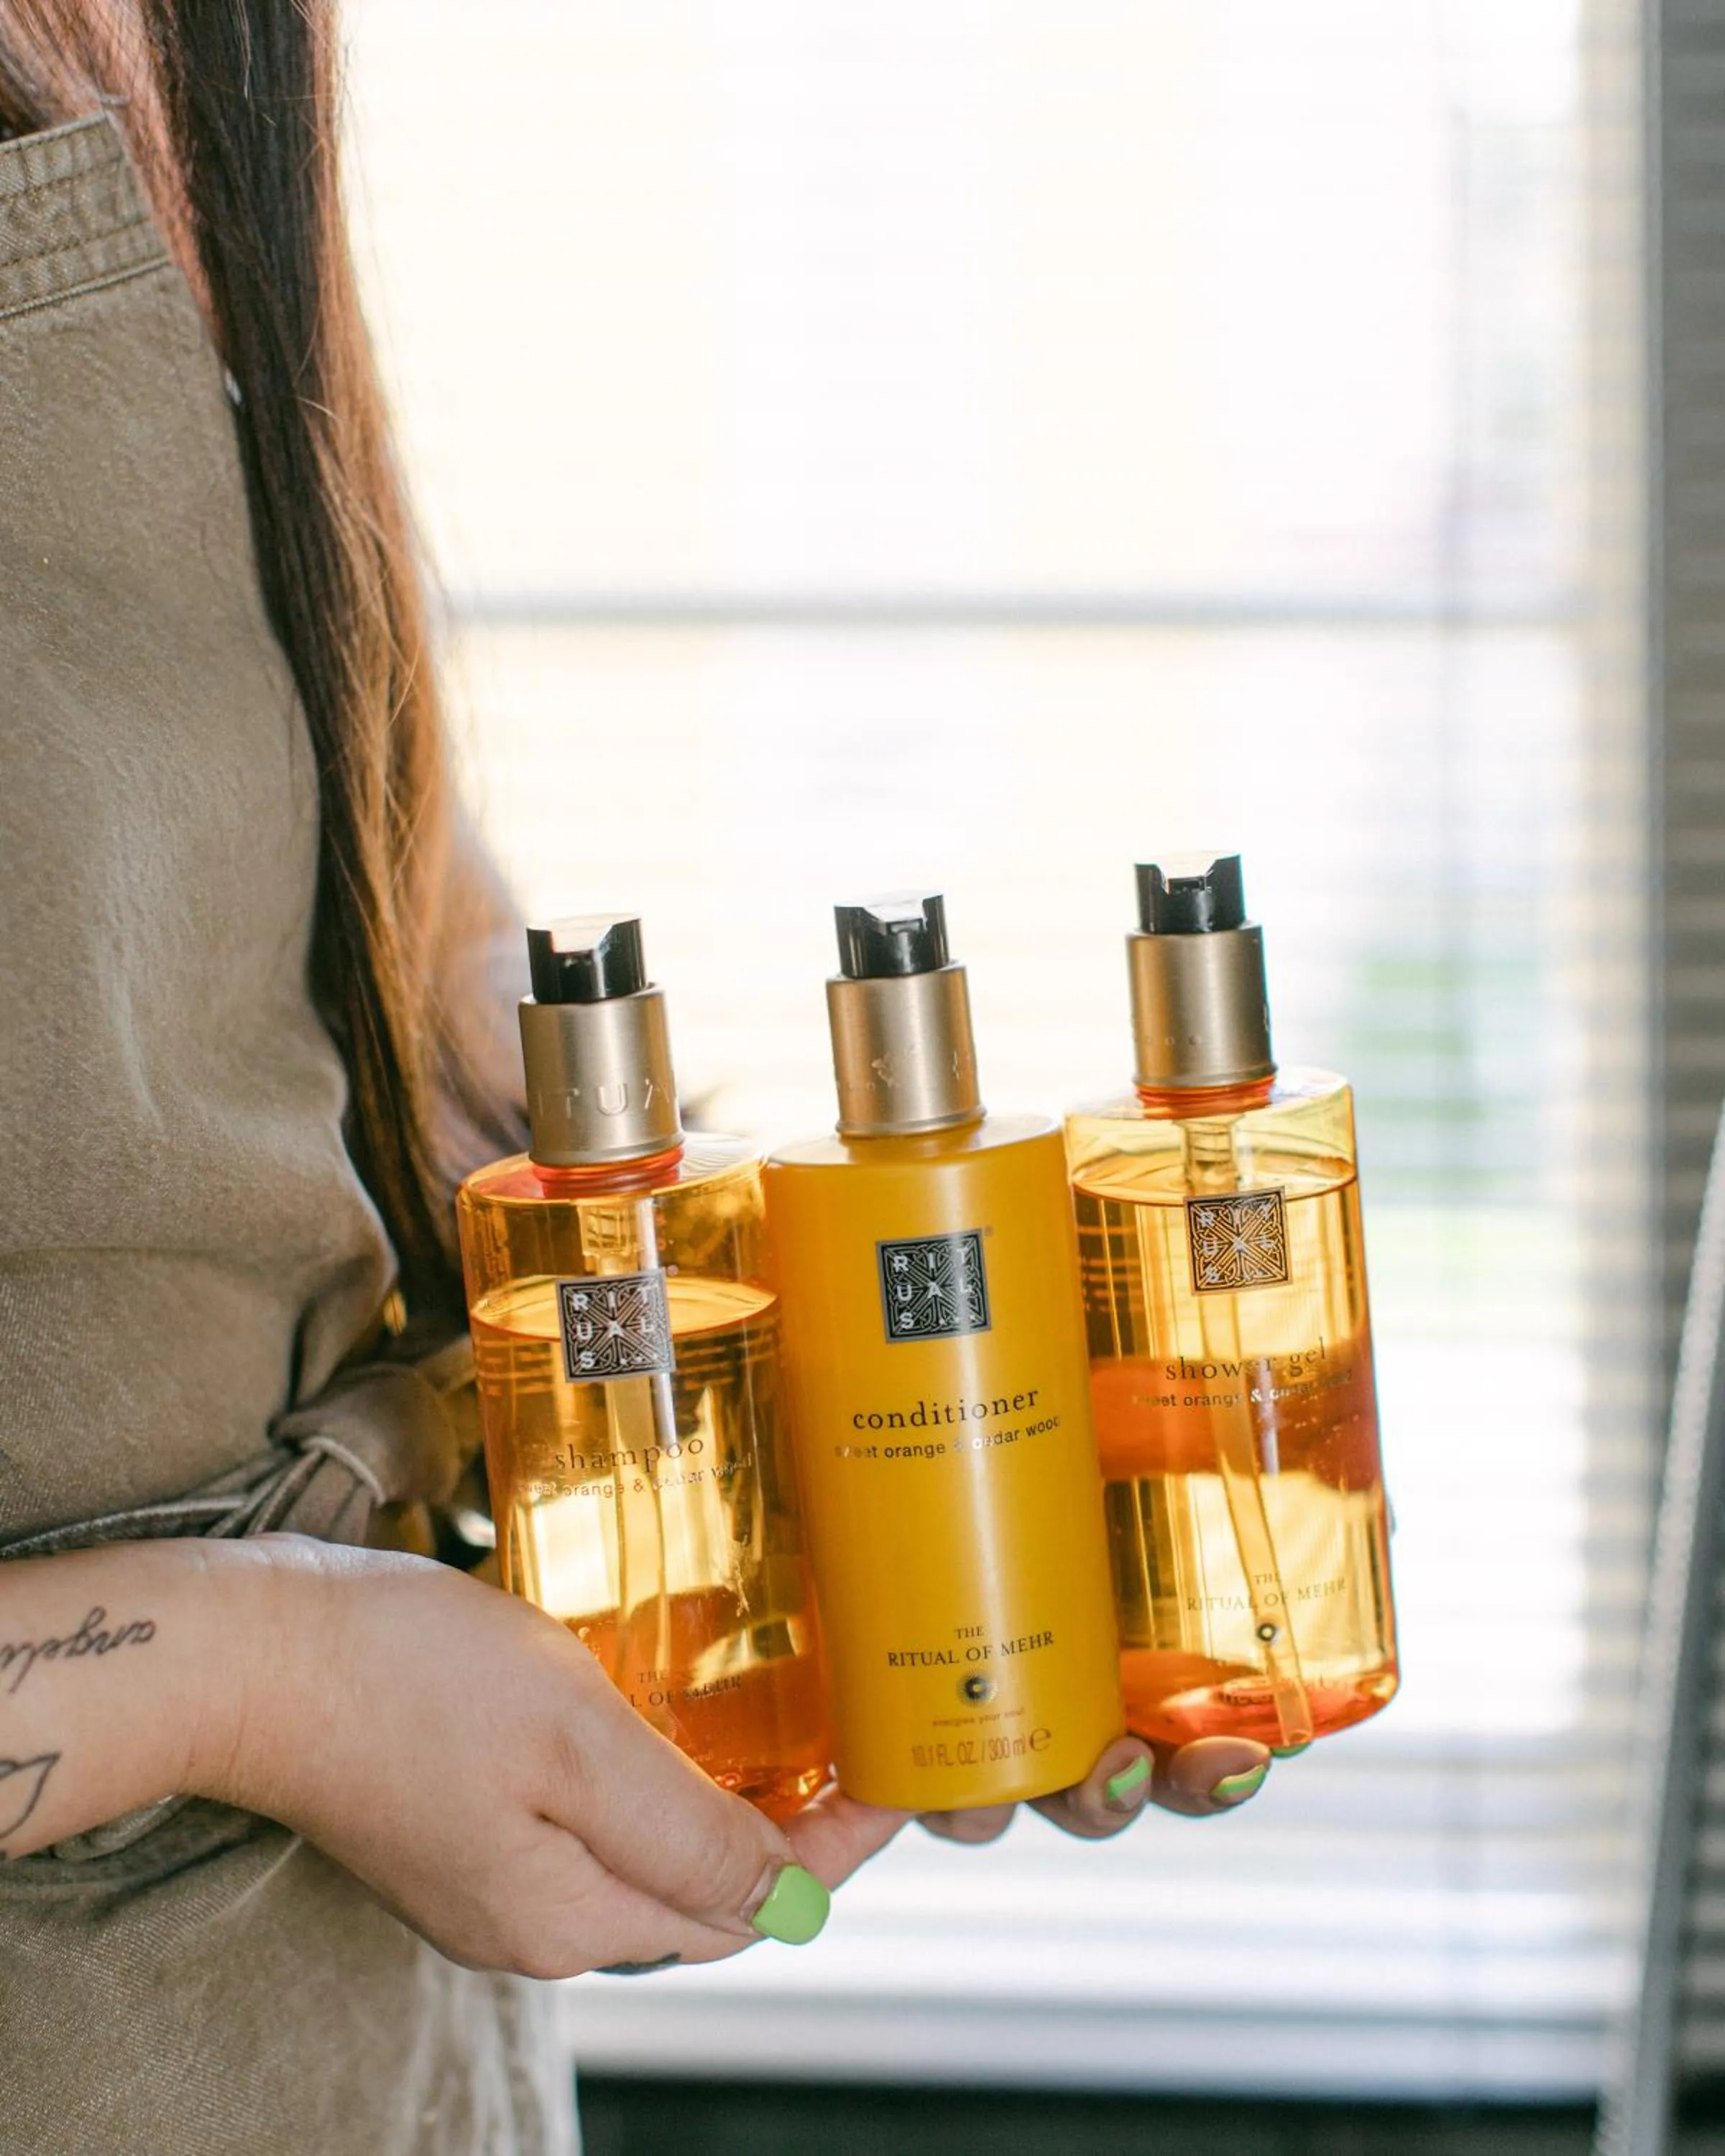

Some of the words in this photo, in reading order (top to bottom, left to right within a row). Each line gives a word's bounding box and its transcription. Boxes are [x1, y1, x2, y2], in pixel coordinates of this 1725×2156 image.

[1289, 1336, 1327, 1378] gel
[852, 1389, 1039, 1430] conditioner
[554, 1438, 704, 1473] shampoo
[884, 1442, 946, 1460] orange
[564, 1481, 625, 1498] orange
[633, 1478, 644, 1494] &
[887, 1649, 960, 1667] RITUAL
[965, 1645, 993, 1662] OF
[1000, 1630, 1054, 1657] MEHR
[954, 1626, 984, 1640] THE
